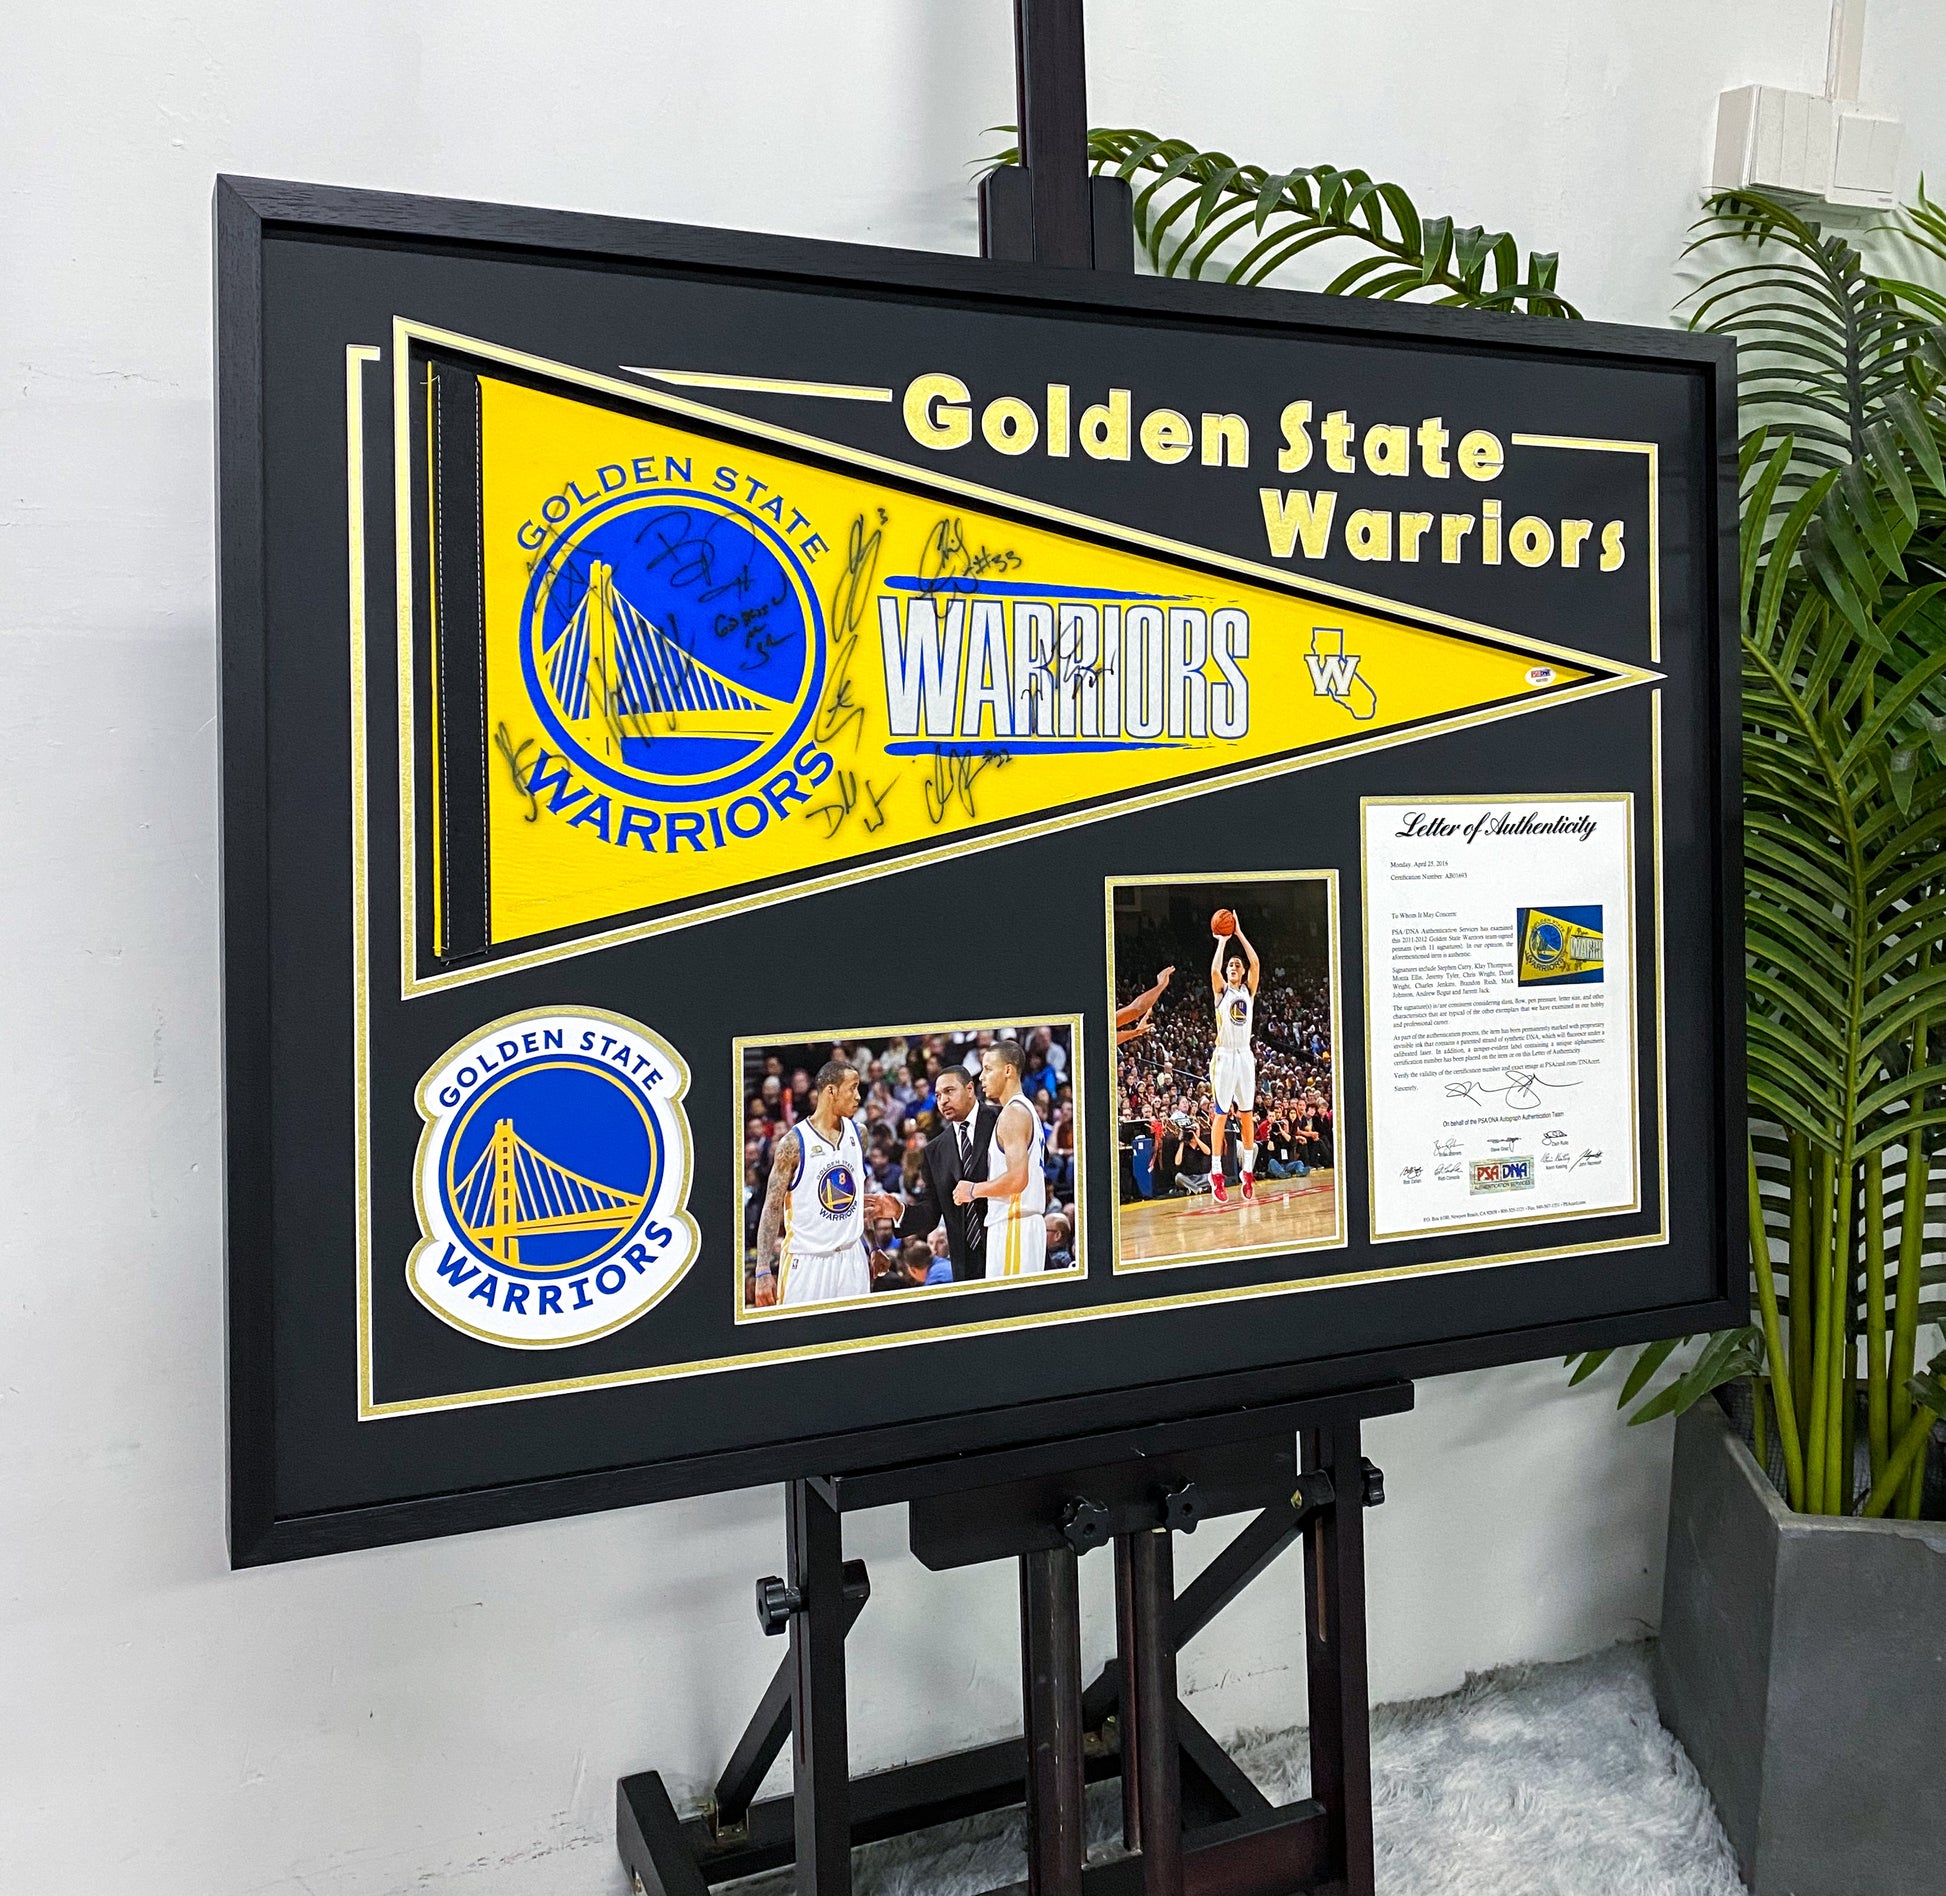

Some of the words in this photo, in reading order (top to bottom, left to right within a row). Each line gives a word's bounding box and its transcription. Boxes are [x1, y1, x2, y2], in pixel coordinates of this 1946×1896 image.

[902, 371, 1250, 468] Golden
[1278, 399, 1505, 482] State
[517, 456, 692, 551] GOLDEN
[711, 465, 831, 564] STATE
[1259, 488, 1627, 573] Warriors
[877, 595, 1250, 739] WARRIORS
[1303, 653, 1361, 696] W
[525, 739, 835, 854] WARRIORS
[1395, 812, 1462, 838] Letter
[1463, 811, 1492, 844] of
[1488, 811, 1597, 842] Authenticity
[439, 1029, 563, 1108] GOLDEN
[580, 1031, 664, 1091] STATE
[839, 1172, 846, 1184] 8
[1477, 1165, 1499, 1181] PSA
[1502, 1162, 1528, 1179] DNA
[435, 1220, 673, 1315] WARRIORS
